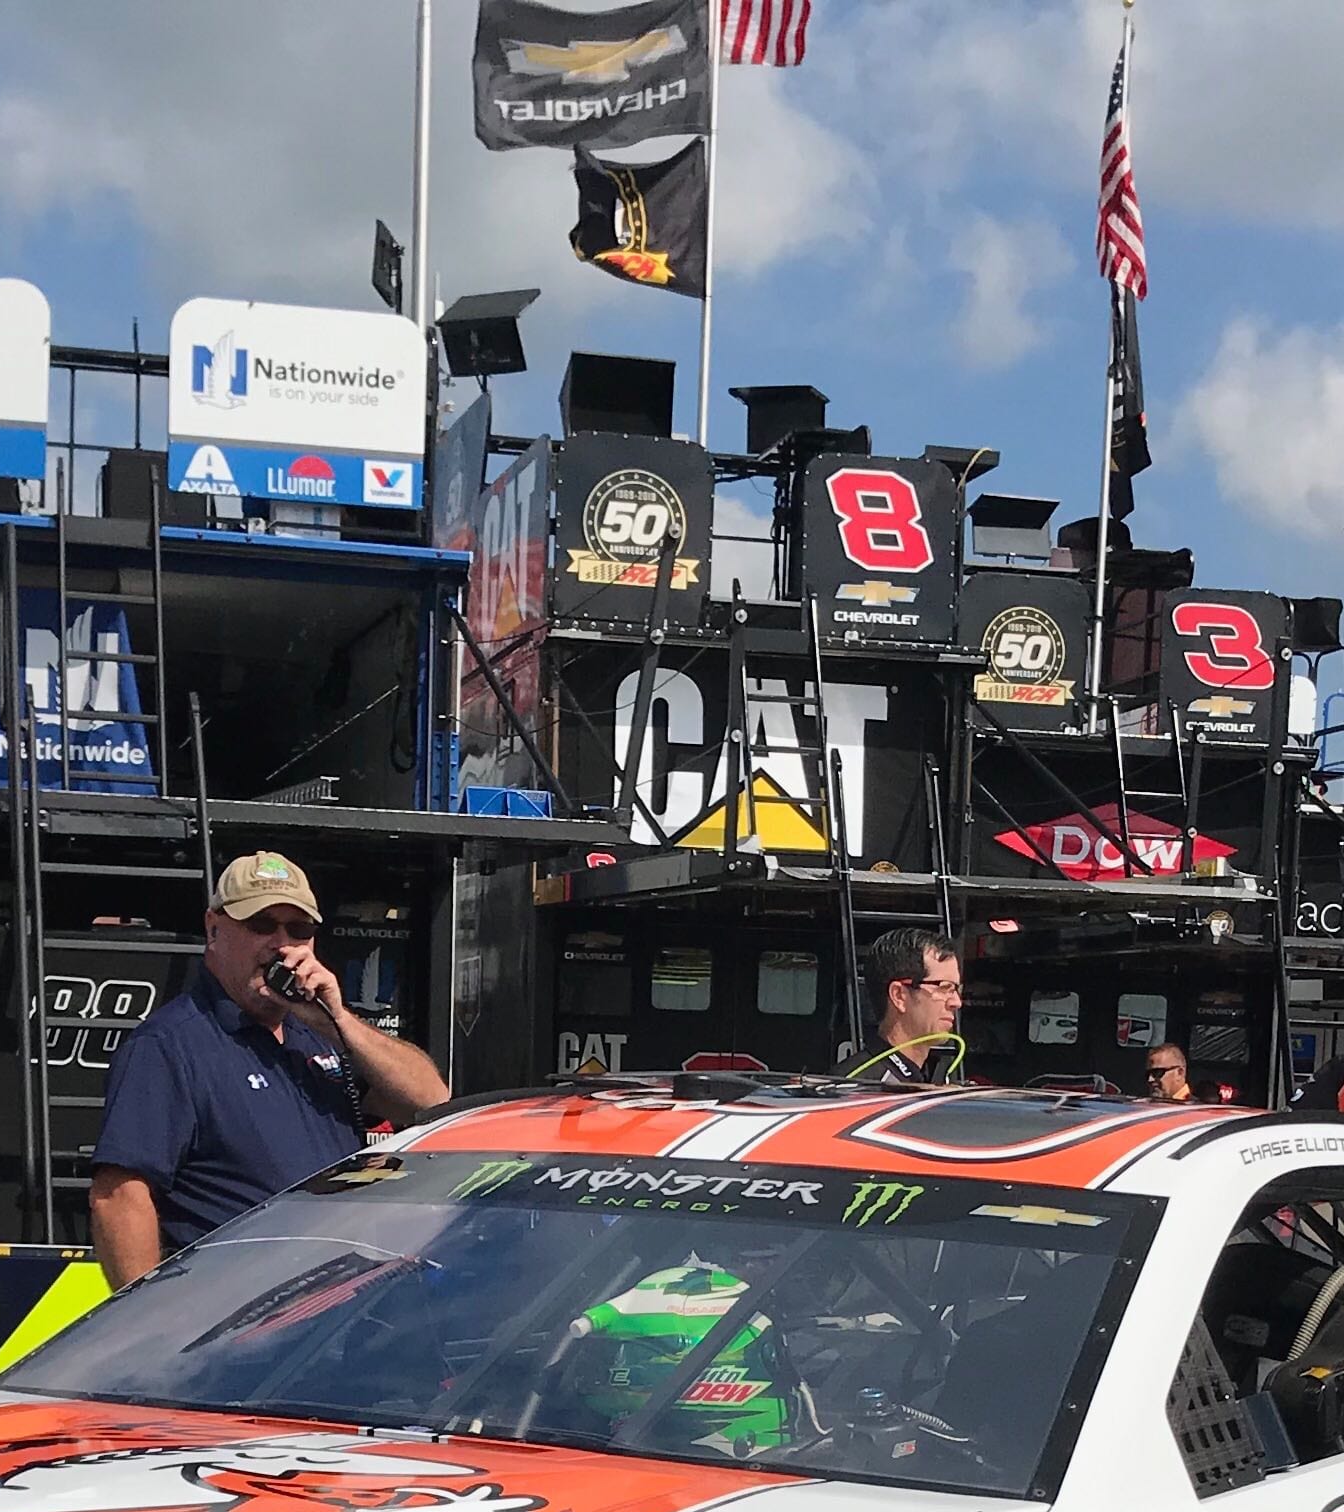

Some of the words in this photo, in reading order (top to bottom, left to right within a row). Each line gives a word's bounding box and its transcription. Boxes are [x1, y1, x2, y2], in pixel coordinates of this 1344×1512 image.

[254, 358, 395, 391] Nationwide
[268, 385, 282, 398] is
[286, 388, 305, 401] on
[309, 390, 343, 405] your
[348, 391, 379, 407] side
[178, 479, 240, 496] AXALTA
[600, 500, 669, 546] 50
[824, 467, 935, 574] 8
[833, 610, 920, 627] CHEVROLET
[995, 632, 1051, 670] 50
[1171, 602, 1276, 691] 3
[613, 667, 888, 858] CAT
[333, 927, 412, 939] CHEVROLET
[564, 950, 626, 961] CHEVROLET
[559, 1032, 627, 1074] CAT
[1240, 1138, 1293, 1166] CHASE
[578, 1194, 741, 1214] ENERGY
